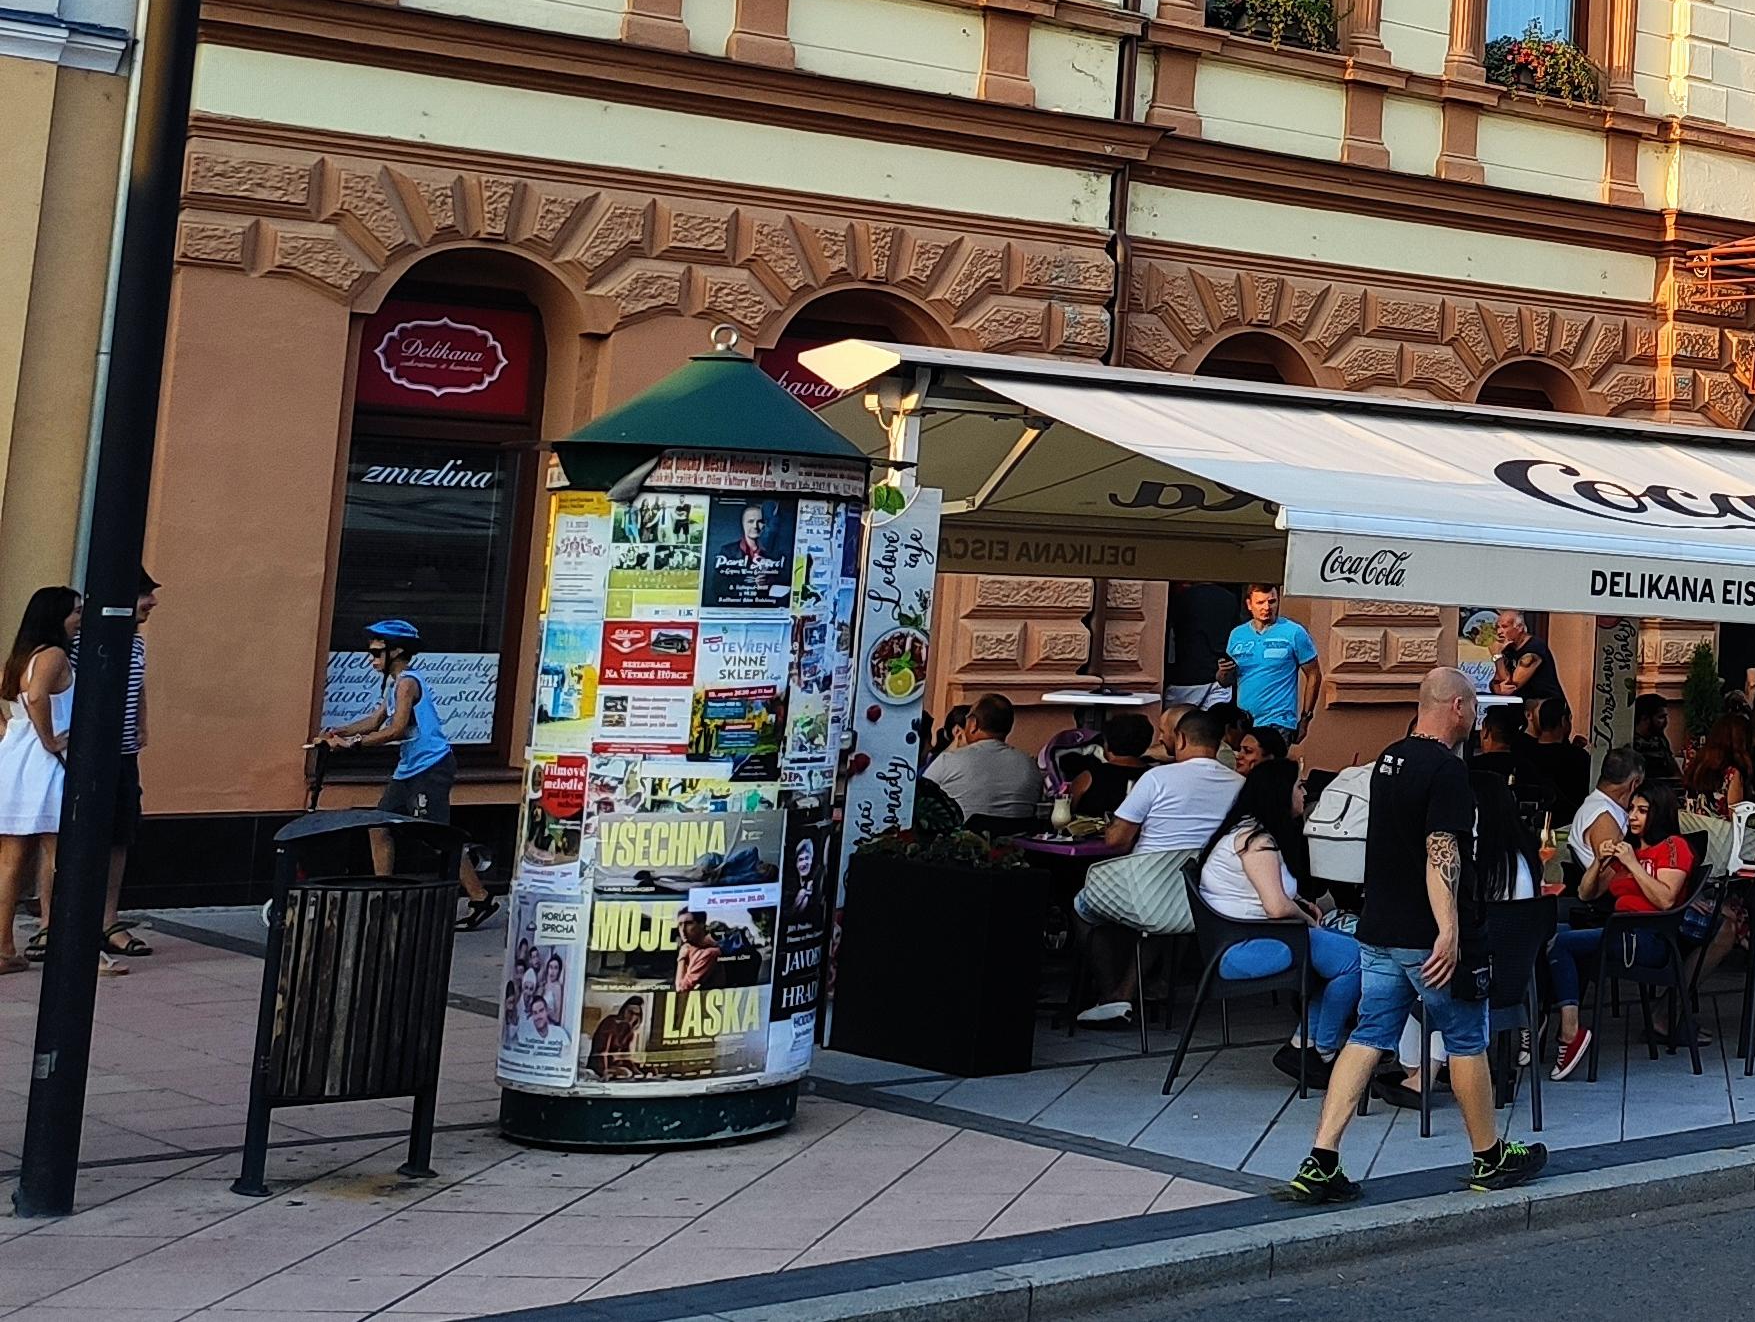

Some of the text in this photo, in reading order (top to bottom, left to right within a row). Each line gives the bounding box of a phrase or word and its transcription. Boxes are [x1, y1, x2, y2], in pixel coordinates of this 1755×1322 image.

[400, 336, 485, 362] Delikana
[361, 459, 496, 489] zmrzlina
[781, 458, 790, 474] 5
[902, 528, 934, 569] čaje
[1320, 545, 1413, 587] Coca-Cola
[867, 530, 902, 620] Ledové
[1590, 569, 1716, 605] DELIKANA
[719, 669, 768, 680] SKLEPY
[723, 652, 767, 666] VINNÉ
[544, 763, 586, 777] Filmové
[544, 778, 584, 791] melodie
[876, 755, 915, 824] onády
[600, 816, 727, 868] VŠECHNA
[590, 900, 679, 952] MOJE
[663, 984, 760, 1039] LÁSKA
